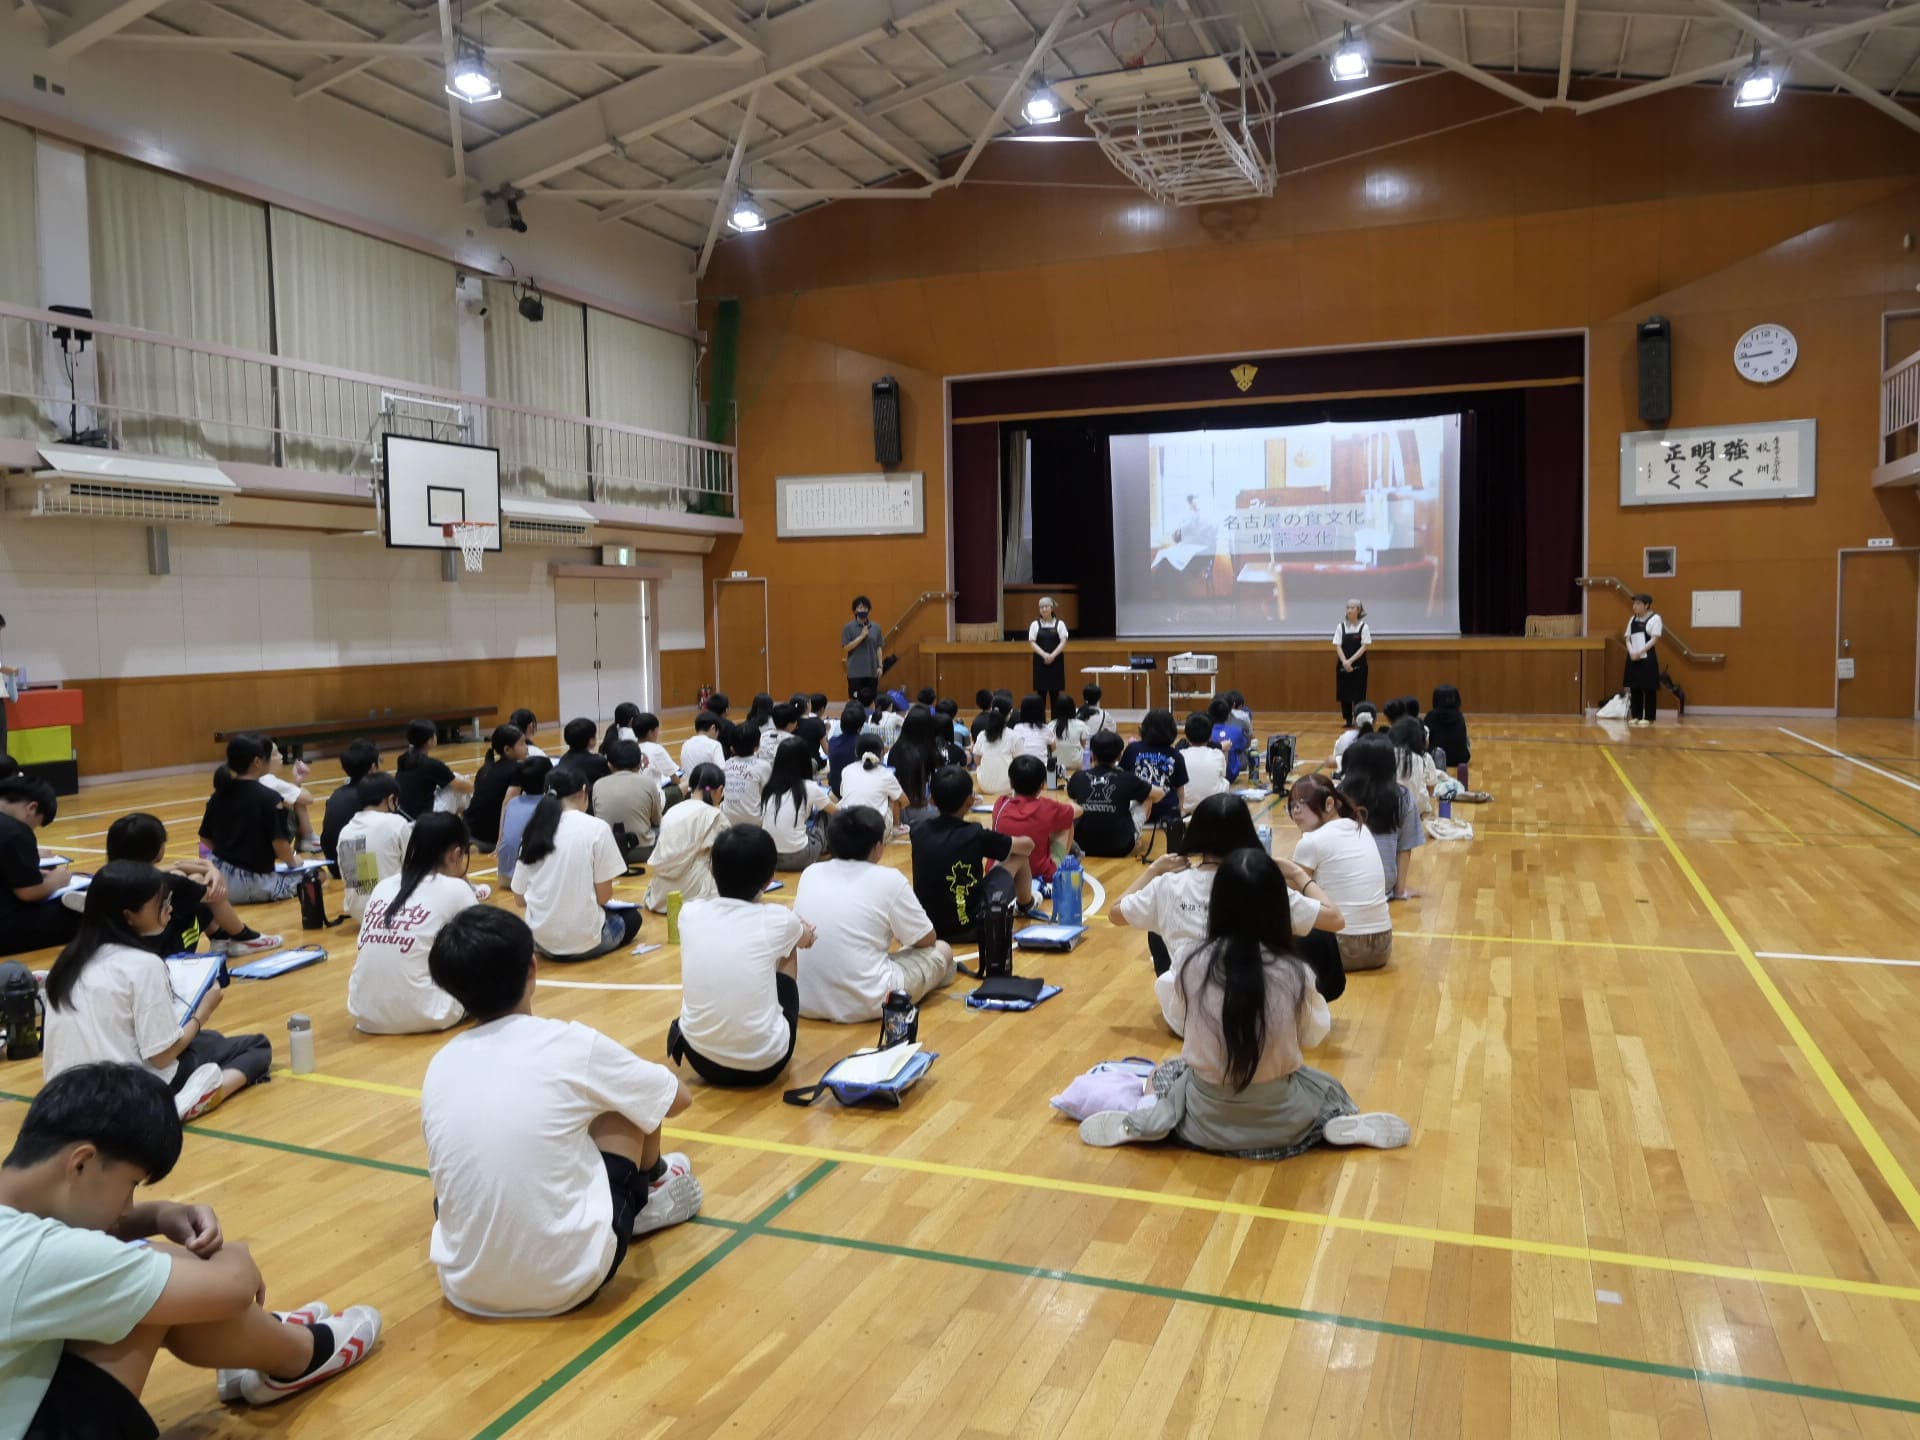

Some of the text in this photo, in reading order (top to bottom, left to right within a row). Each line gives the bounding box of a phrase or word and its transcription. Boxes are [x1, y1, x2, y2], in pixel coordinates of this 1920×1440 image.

[1743, 341, 1752, 349] 10
[1664, 443, 1686, 490] 正しく
[1690, 440, 1716, 489] 明るく
[1723, 438, 1750, 487] 強く
[1224, 509, 1365, 530] 名古屋の食文化
[365, 900, 431, 925] Lirty
[358, 929, 416, 953] Growing
